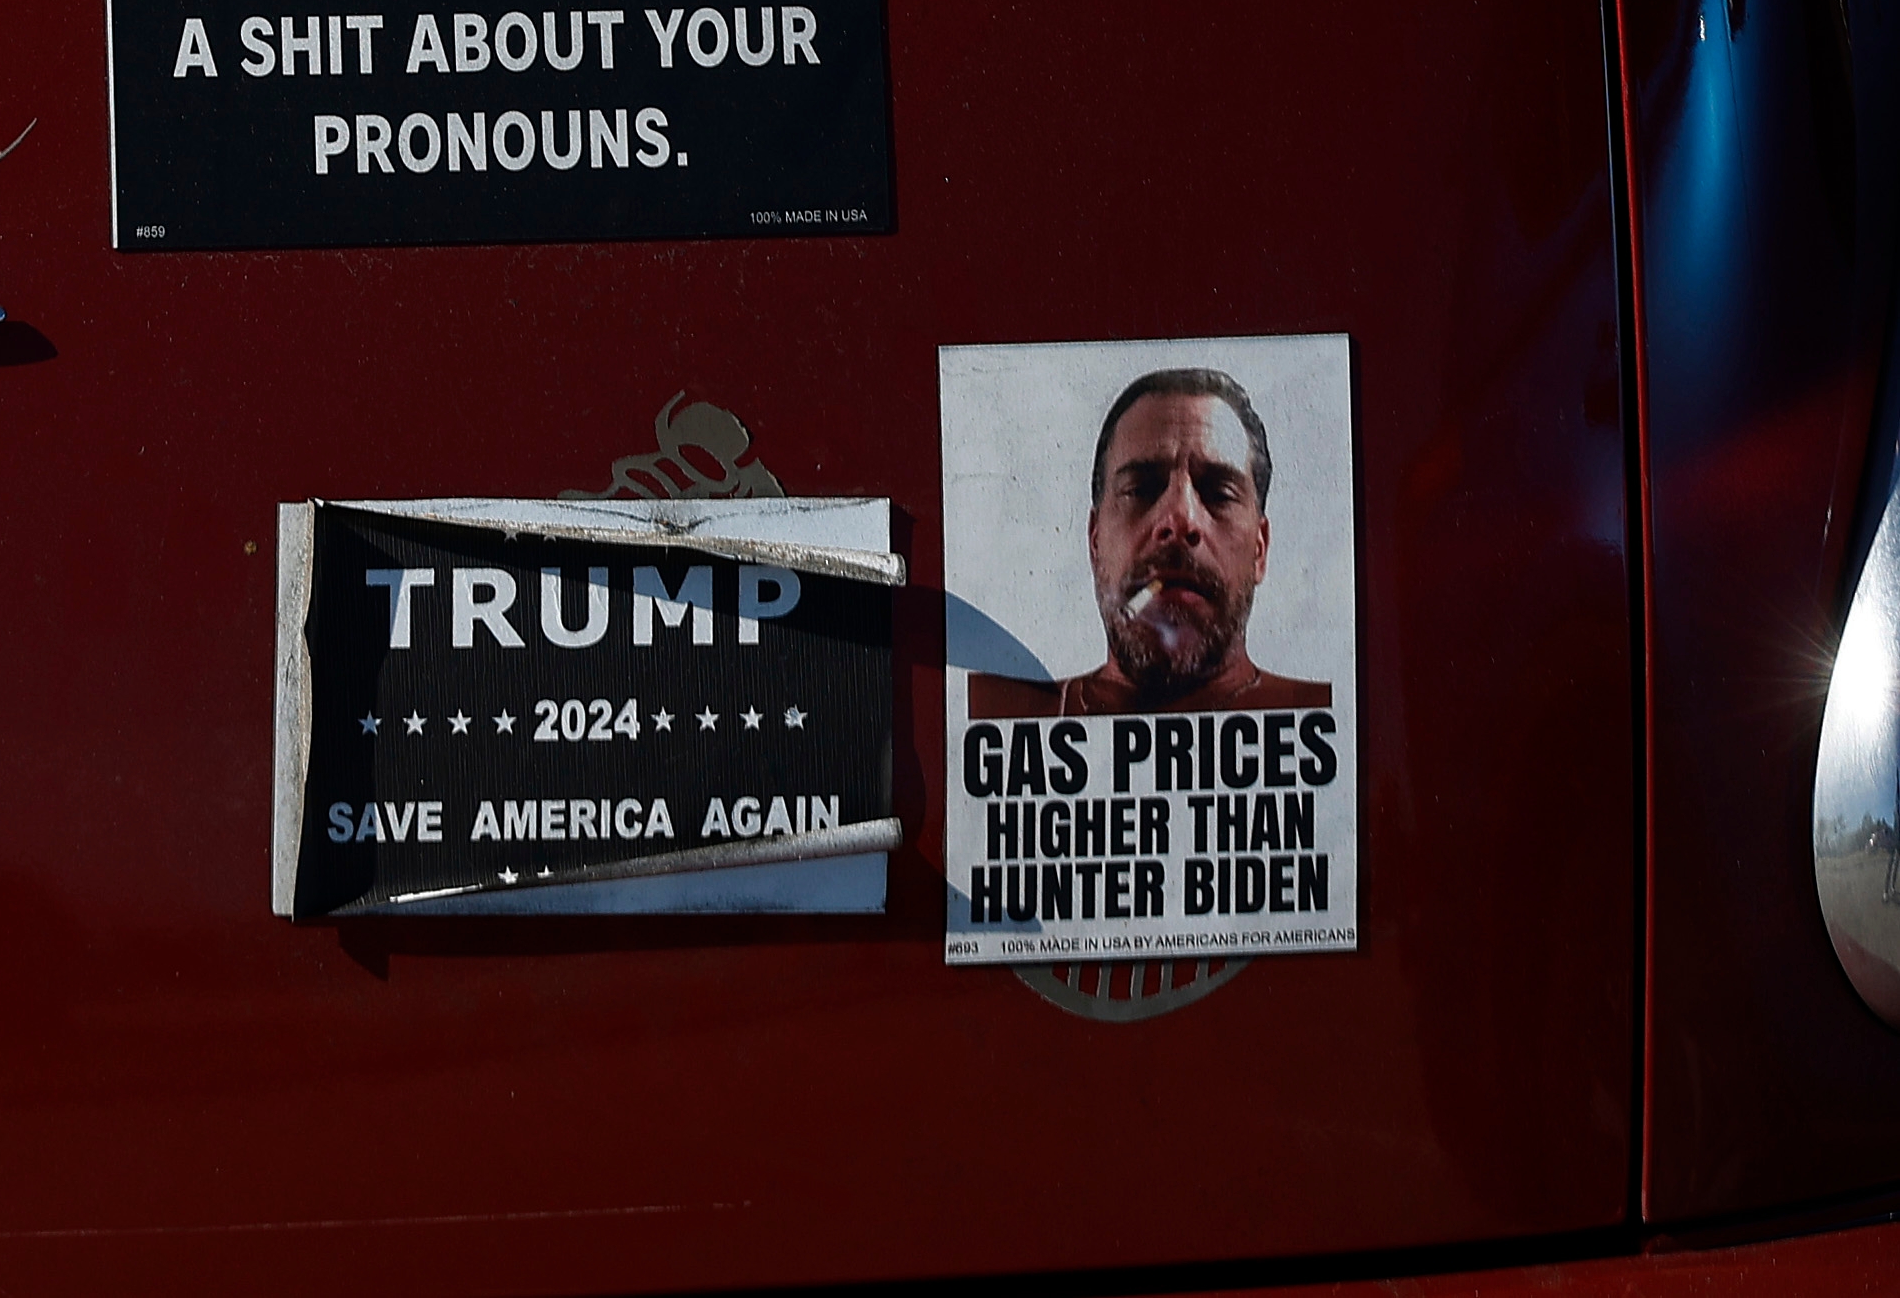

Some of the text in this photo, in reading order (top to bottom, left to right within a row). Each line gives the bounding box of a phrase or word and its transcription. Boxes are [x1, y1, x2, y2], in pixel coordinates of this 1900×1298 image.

[174, 7, 820, 77] A SHIT ABOUT YOUR
[315, 108, 687, 174] PRONOUNS.
[137, 226, 165, 238] #859
[751, 209, 867, 224] 100% MADE IN USA
[366, 567, 800, 649] TRUMP
[534, 699, 640, 741] 2024
[963, 711, 1338, 798] GAS PRICES
[328, 794, 839, 842] SAVE AMERICA AGAIN
[987, 791, 1315, 860] HIGHER THAN
[970, 854, 1330, 922] HUNTER BIDEN
[1002, 929, 1355, 954] 100% MADE IN USA BY AMERICANS FOR AMERICANS
